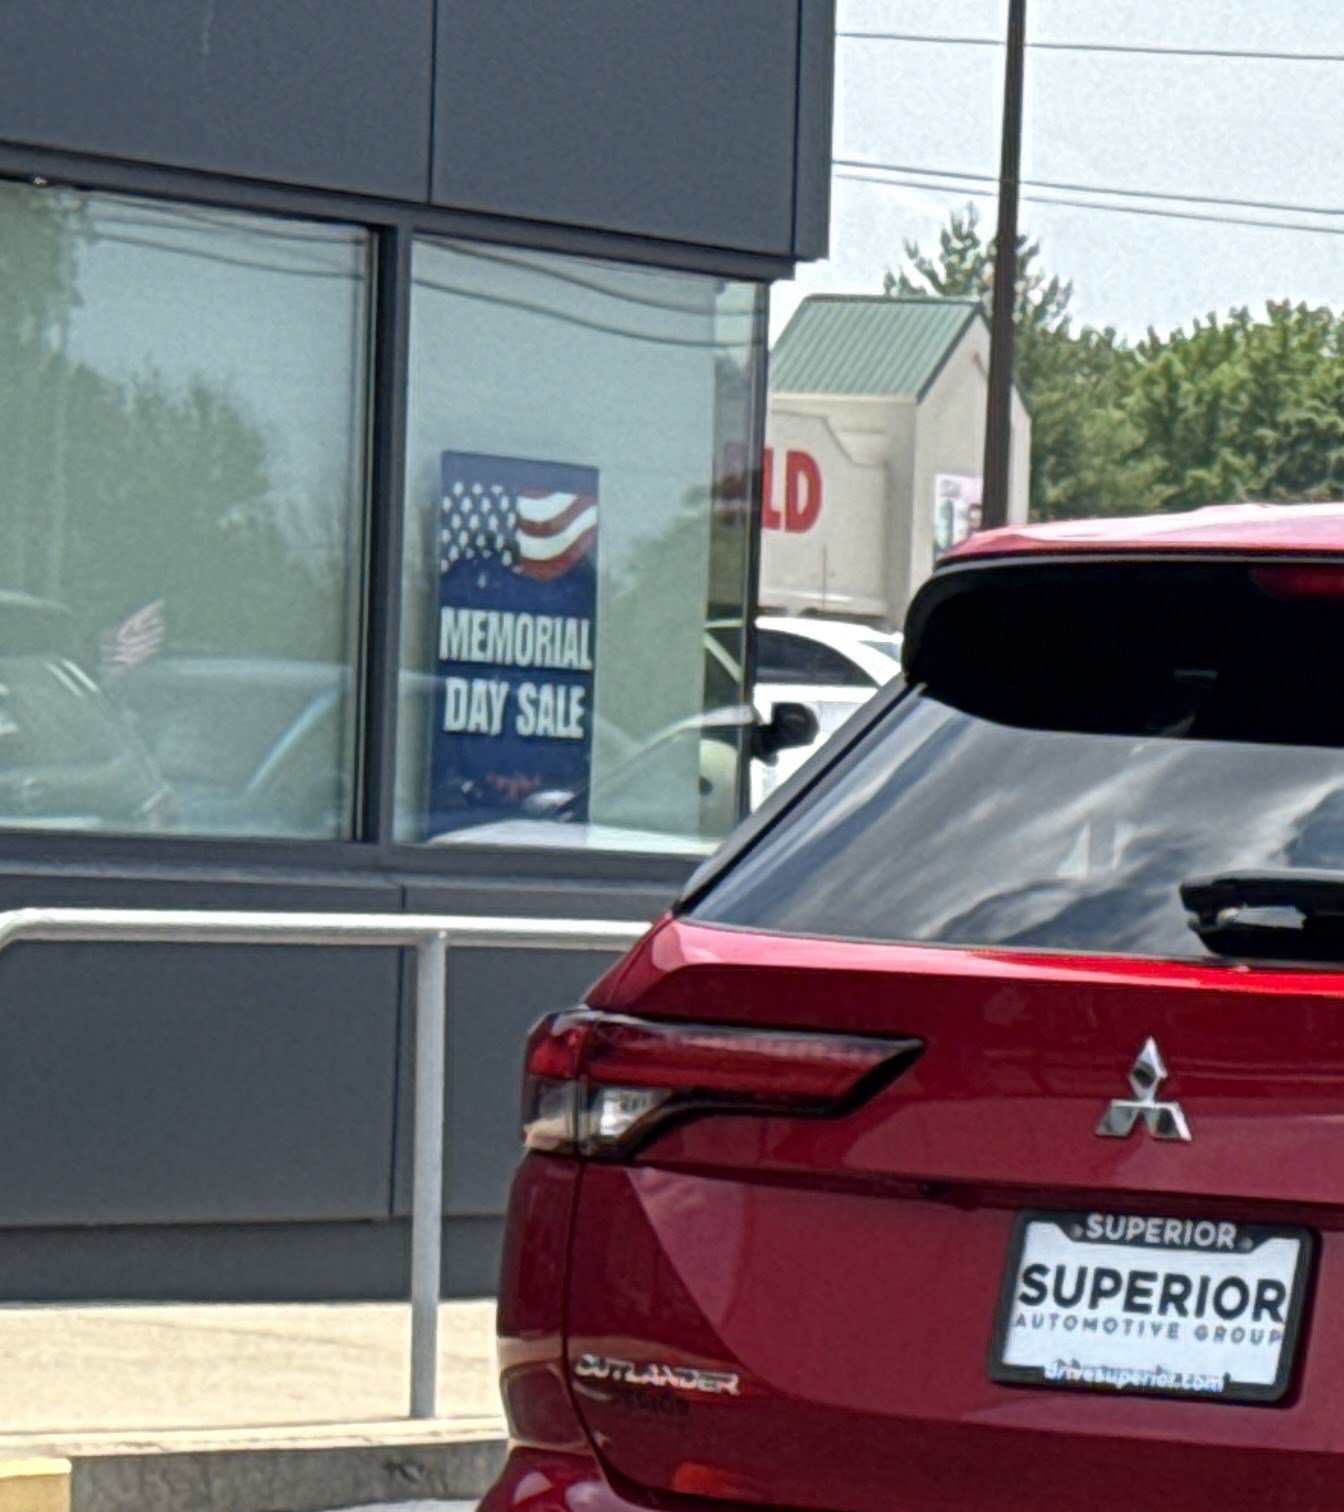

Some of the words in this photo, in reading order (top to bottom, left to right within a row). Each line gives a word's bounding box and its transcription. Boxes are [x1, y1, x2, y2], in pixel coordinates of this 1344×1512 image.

[760, 447, 822, 533] LD
[438, 606, 593, 670] MEMORIAL
[443, 676, 509, 735] DAY
[516, 681, 586, 739] SALE
[1085, 1212, 1237, 1250] SUPERIOR
[1018, 1262, 1287, 1323] SUPERIOR
[1015, 1312, 1181, 1341] AUTOMOTIVE
[1193, 1324, 1284, 1346] GROUP
